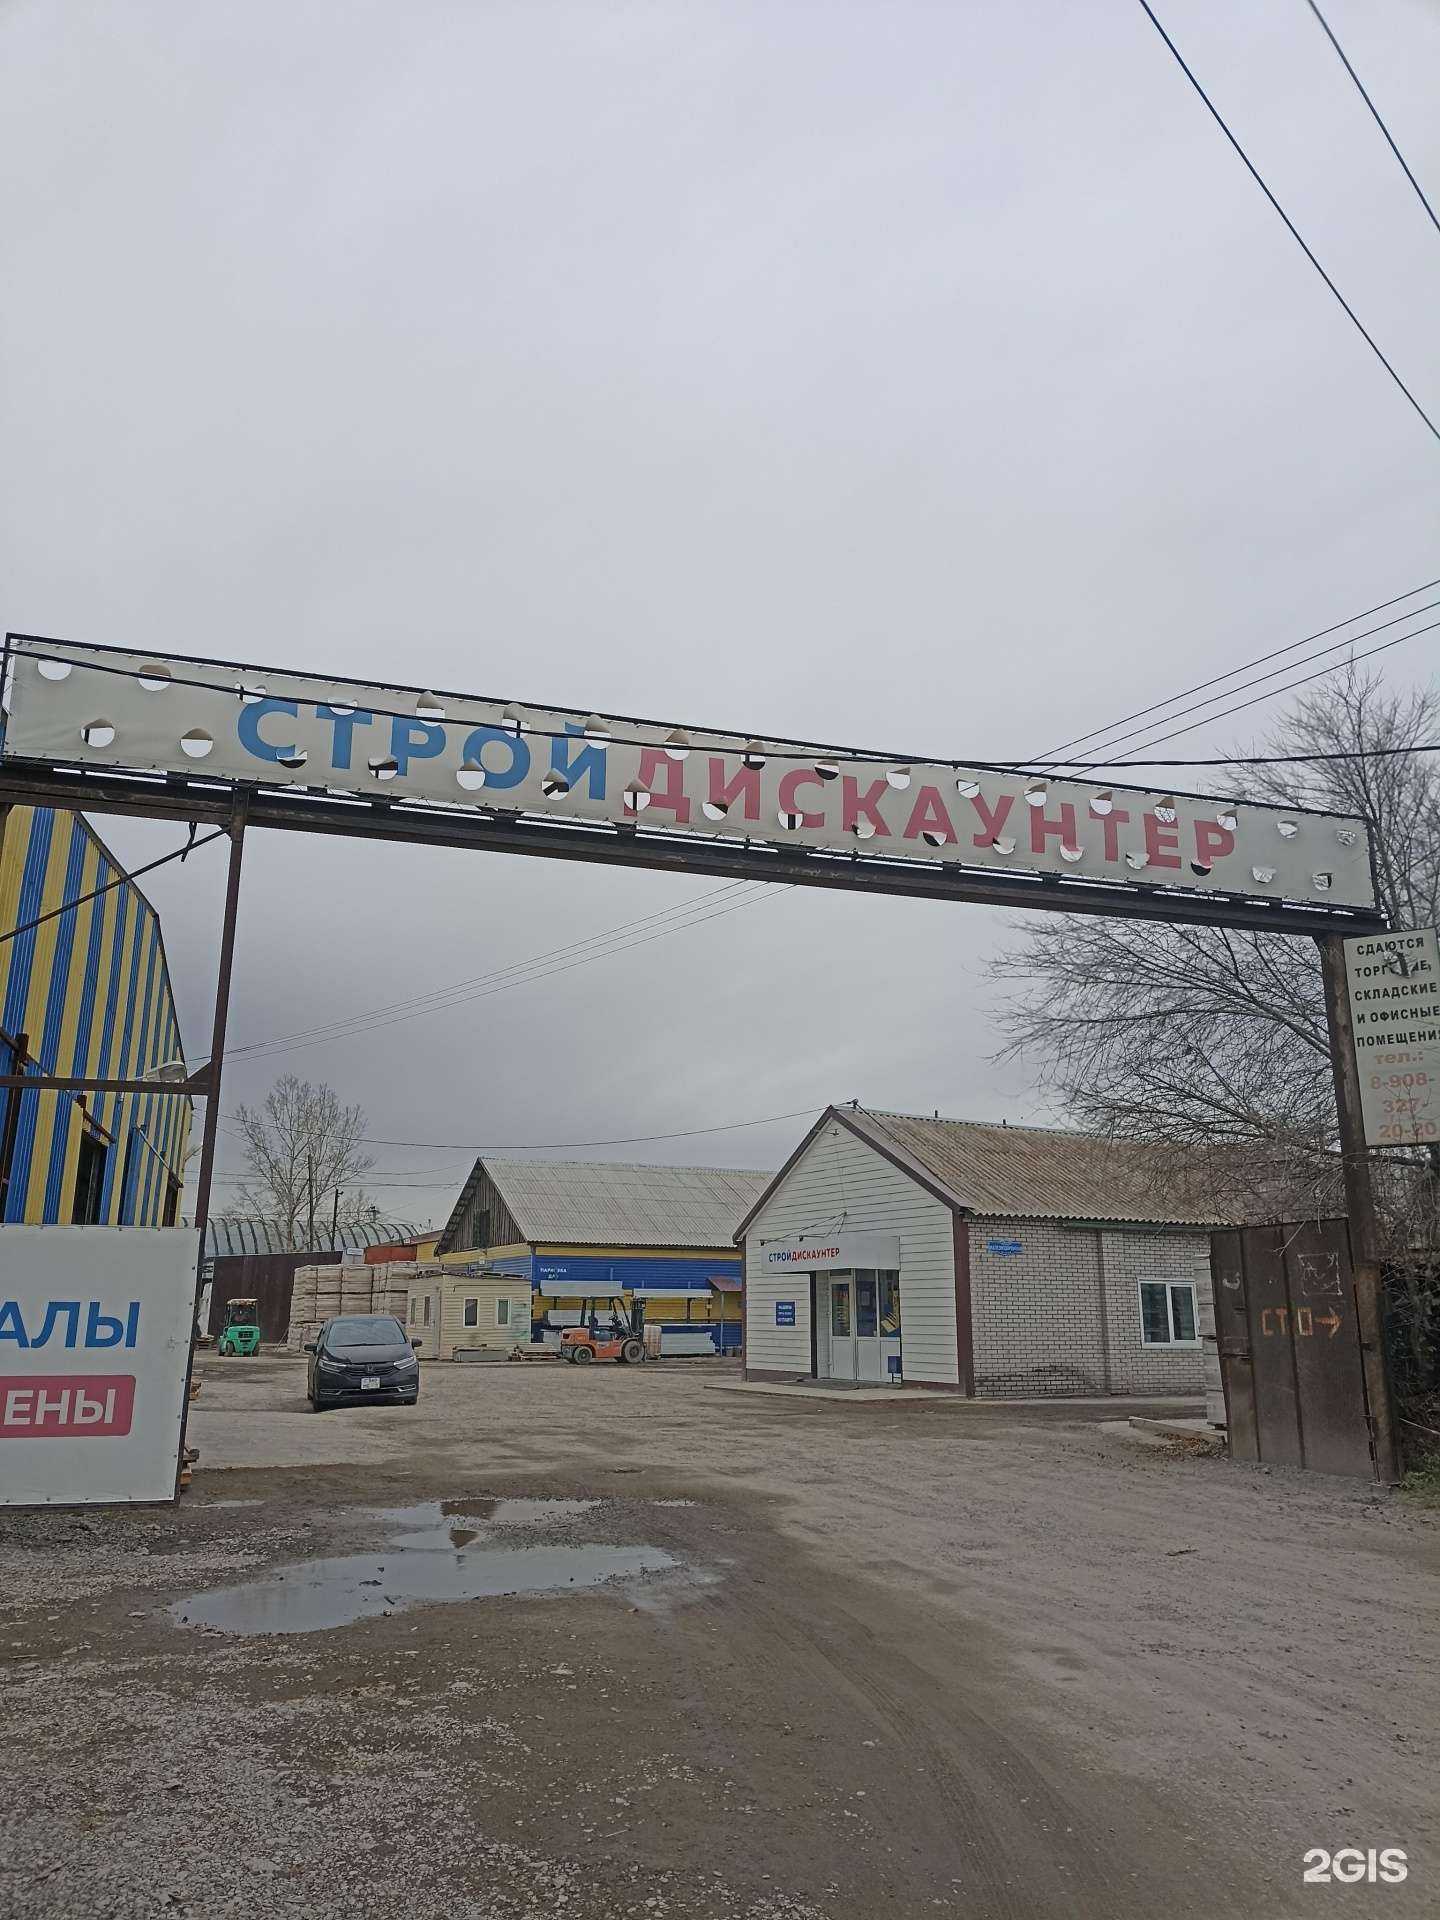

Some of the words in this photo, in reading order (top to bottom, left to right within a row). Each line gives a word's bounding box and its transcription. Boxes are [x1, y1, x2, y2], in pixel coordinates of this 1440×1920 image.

[1356, 937, 1425, 956] СДАЮТСЯ
[1354, 982, 1438, 1001] СКЛАДСКИЕ
[1357, 1013, 1366, 1024] И
[1370, 1005, 1440, 1023] ОФИСНЫЕ
[1374, 1051, 1424, 1065] тел.:
[769, 1248, 840, 1262] СТРОЙДИСКАУНТЕР
[1261, 1306, 1313, 1336] СТО
[3, 1389, 116, 1425] ЕНЫ
